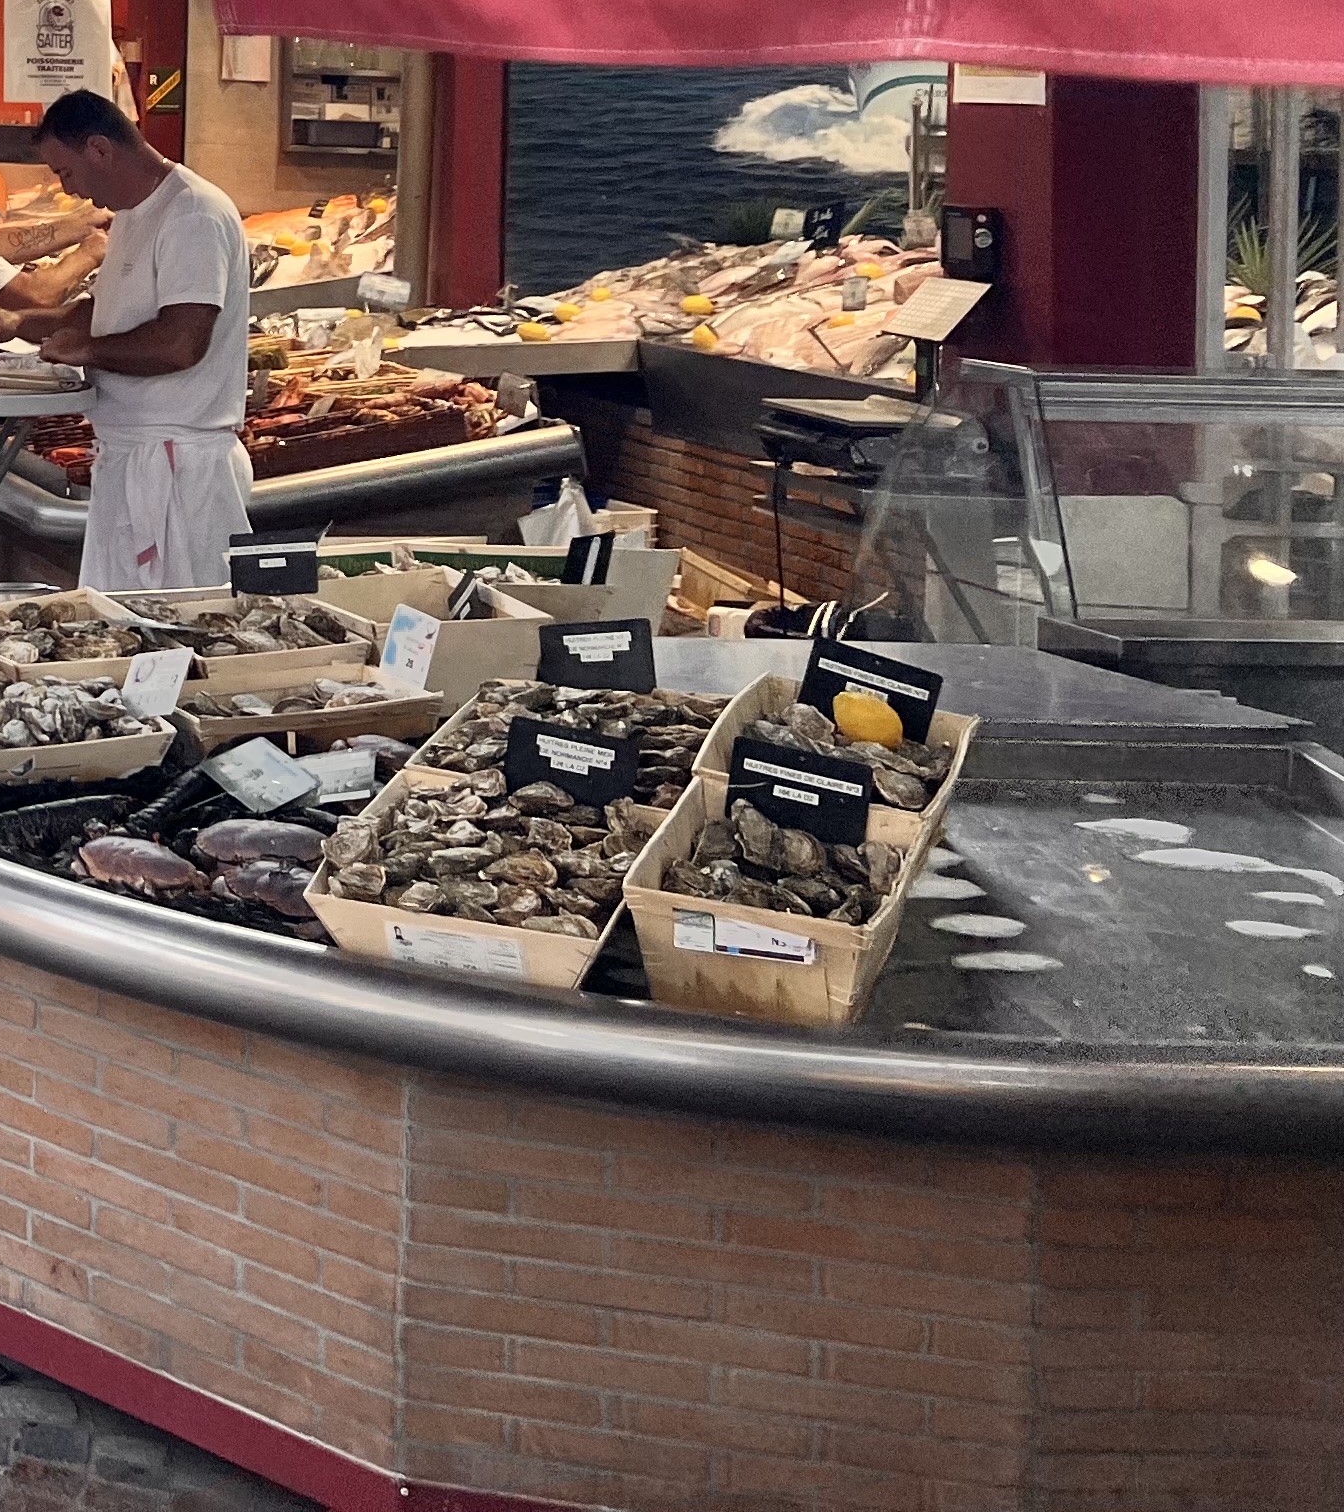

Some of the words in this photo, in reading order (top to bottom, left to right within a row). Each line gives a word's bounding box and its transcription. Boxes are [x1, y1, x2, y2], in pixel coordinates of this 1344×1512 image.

[37, 33, 72, 48] SAITER
[538, 737, 569, 749] HUITRES
[570, 744, 595, 755] PLEINE
[551, 749, 593, 763] NORMANDIE
[745, 761, 778, 775] HUITRES
[779, 769, 802, 780] FINES
[804, 775, 815, 784] DE
[816, 778, 845, 791] CLAIRE
[792, 791, 802, 799] LA
